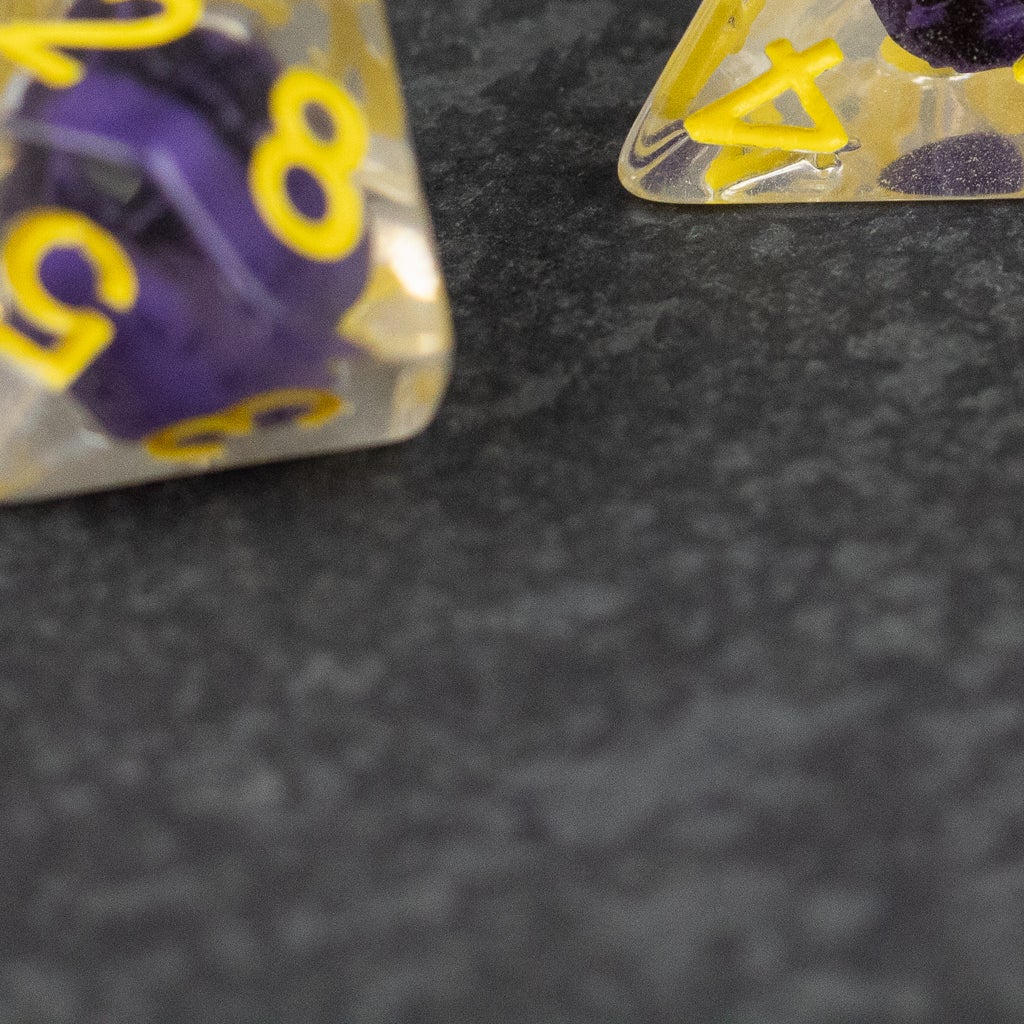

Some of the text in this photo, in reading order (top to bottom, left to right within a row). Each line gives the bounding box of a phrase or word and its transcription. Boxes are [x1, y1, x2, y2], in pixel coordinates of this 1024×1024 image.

[249, 68, 368, 262] 8
[685, 38, 848, 153] 4
[0, 206, 138, 391] 5
